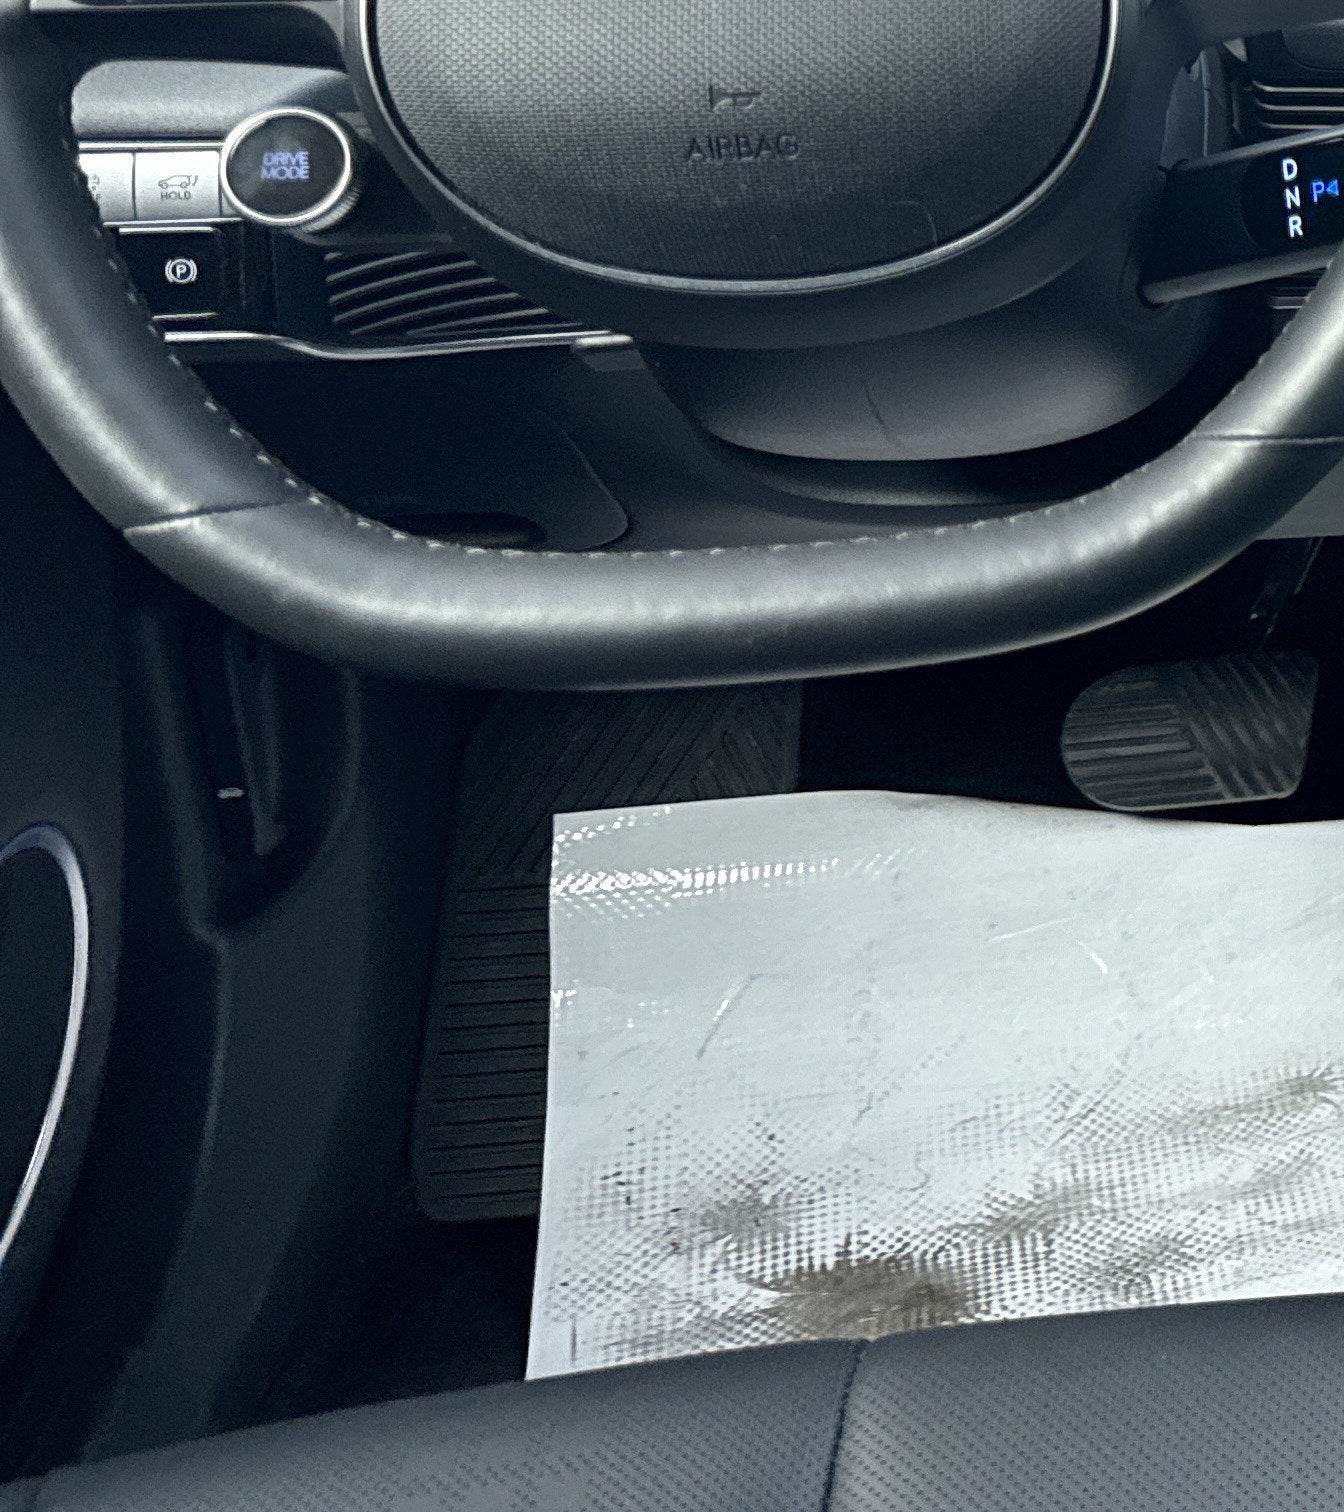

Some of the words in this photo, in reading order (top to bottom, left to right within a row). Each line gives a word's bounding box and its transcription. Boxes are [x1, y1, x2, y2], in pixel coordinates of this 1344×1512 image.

[263, 151, 308, 166] DRIVE
[688, 136, 799, 160] AIRBAG
[261, 166, 309, 179] MODE
[1282, 159, 1297, 180] D
[161, 191, 191, 200] HOLD
[1285, 188, 1300, 209] N
[1289, 215, 1303, 237] R
